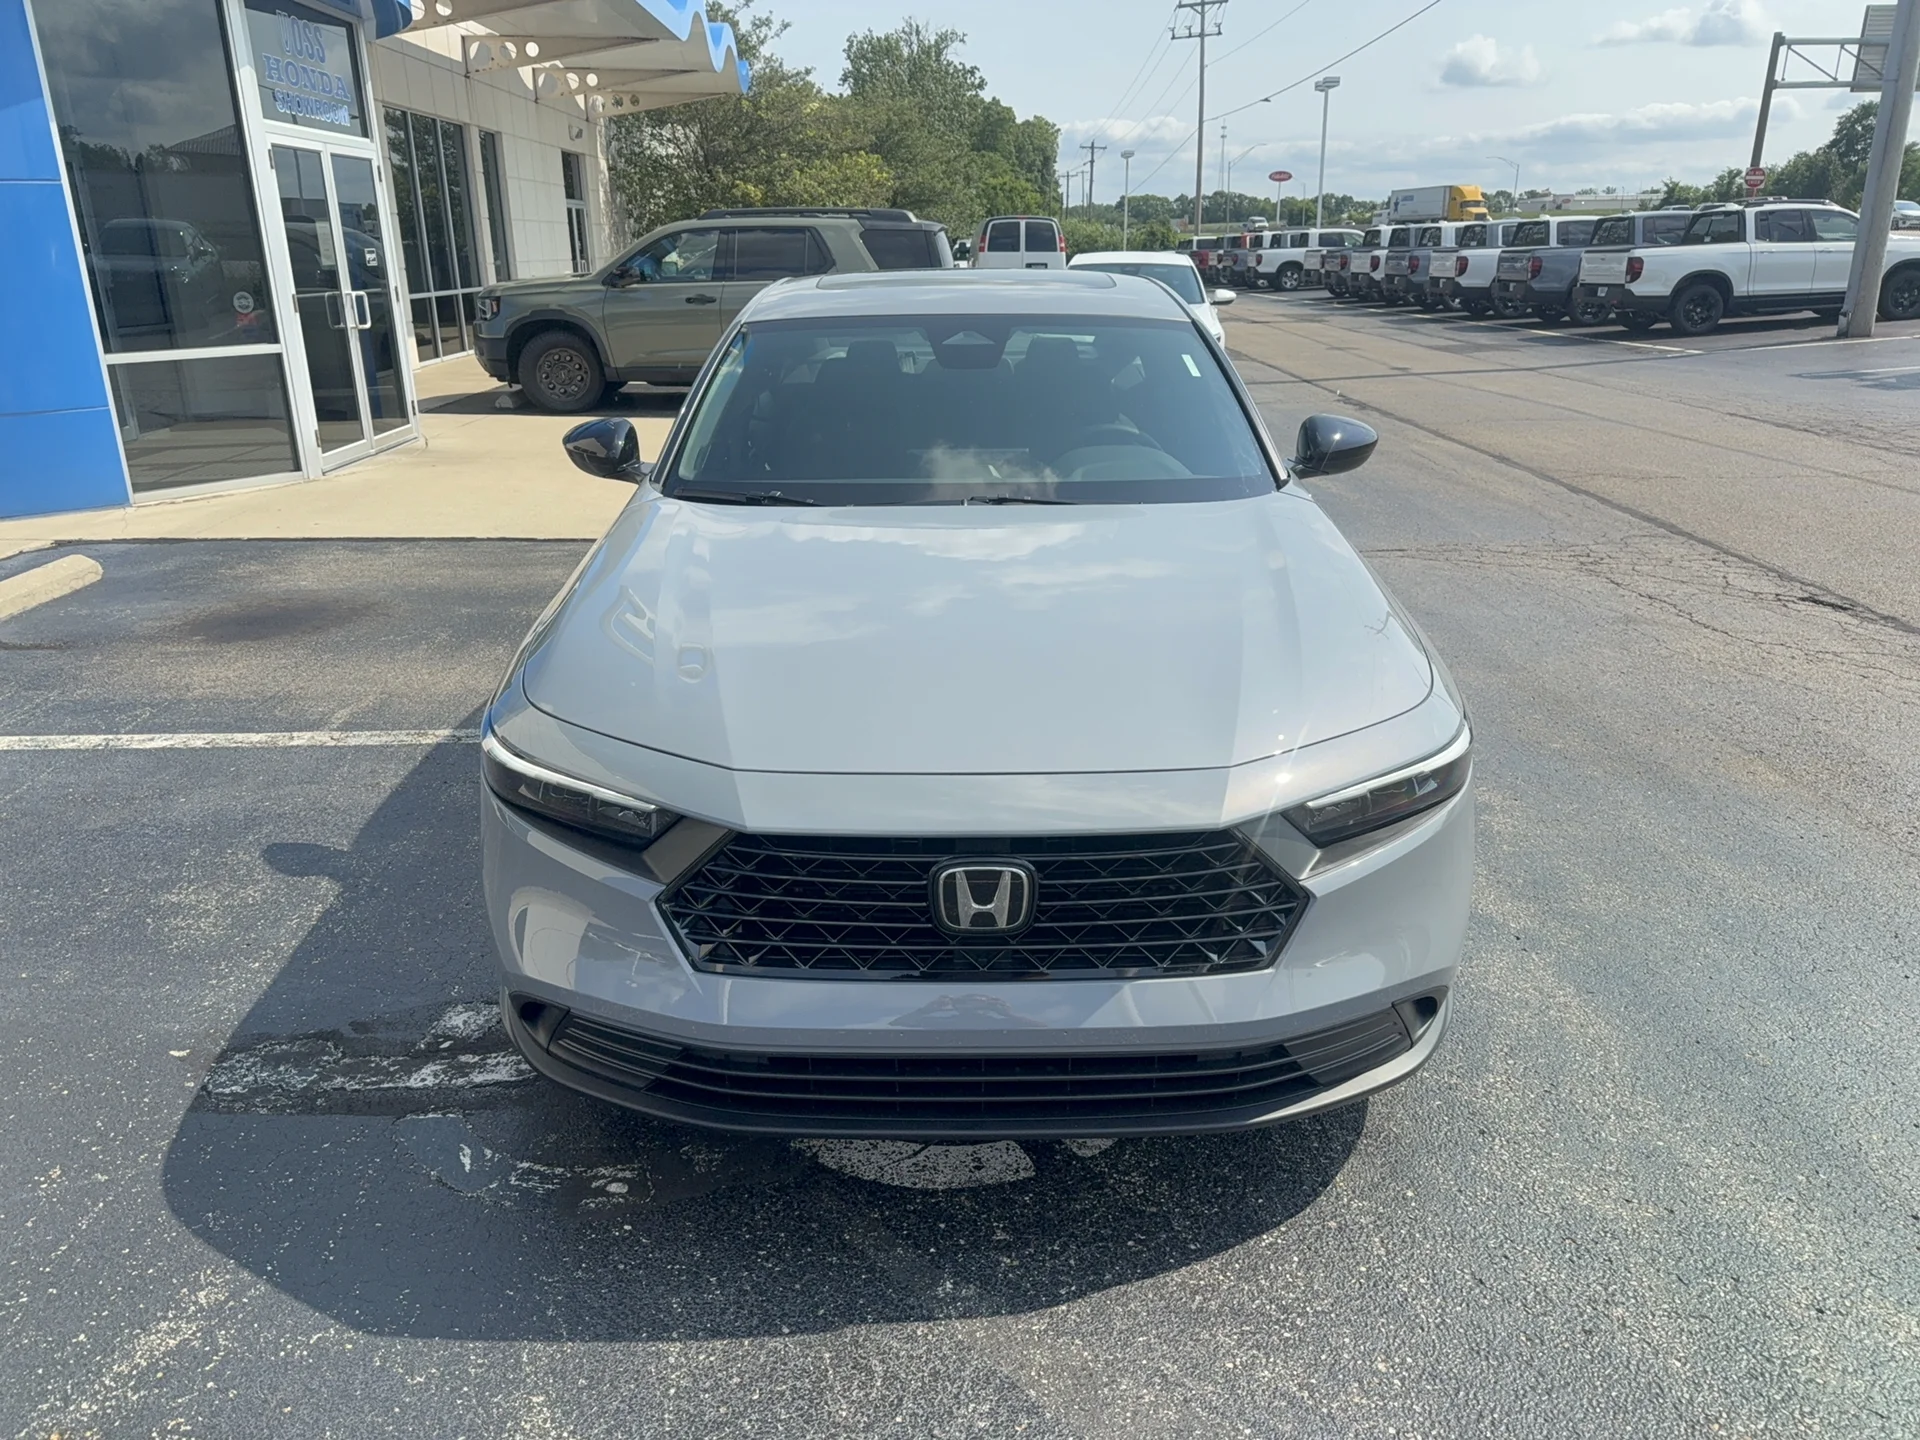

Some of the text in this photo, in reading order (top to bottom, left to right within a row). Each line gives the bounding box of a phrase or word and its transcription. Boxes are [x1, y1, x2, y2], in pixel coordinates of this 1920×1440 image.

[276, 9, 326, 64] VOSS
[262, 53, 351, 102] HONDA
[274, 88, 351, 126] SHOWROOM
